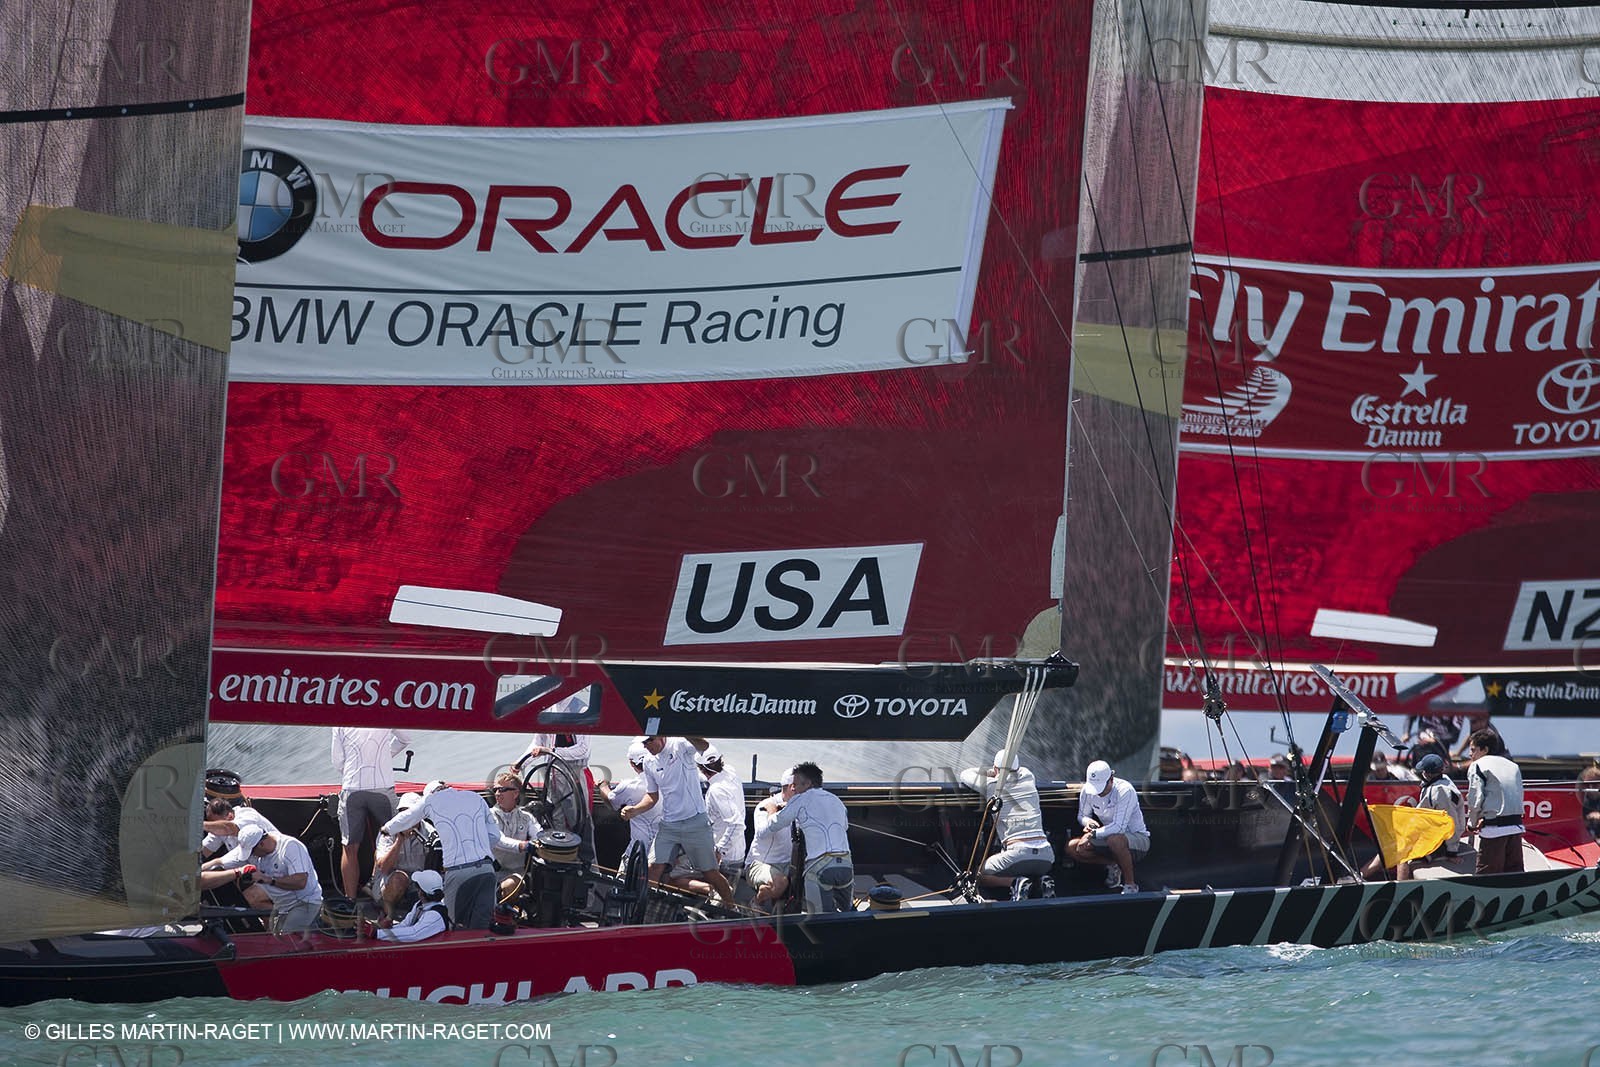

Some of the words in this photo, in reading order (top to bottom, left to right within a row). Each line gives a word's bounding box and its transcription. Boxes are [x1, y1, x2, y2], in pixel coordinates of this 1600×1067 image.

[249, 150, 312, 190] MW
[358, 164, 910, 254] ORACLE
[230, 296, 375, 345] BMW
[388, 301, 647, 347] ORACLE
[660, 295, 845, 347] Racing
[1351, 394, 1468, 424] Estrella
[1365, 424, 1442, 448] Damm
[684, 556, 889, 634] USA
[875, 699, 968, 716] TOYOTA
